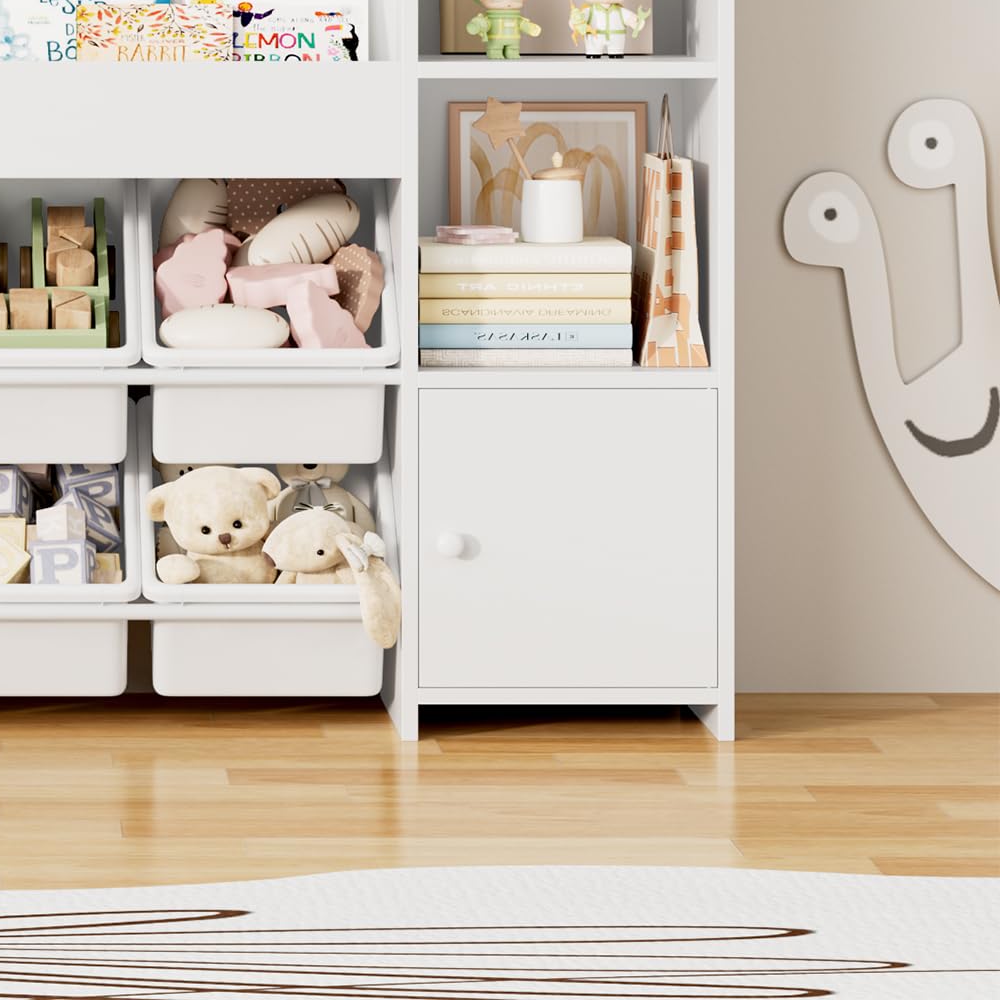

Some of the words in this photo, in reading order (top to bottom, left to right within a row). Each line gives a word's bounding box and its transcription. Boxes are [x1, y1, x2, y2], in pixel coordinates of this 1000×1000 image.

[47, 39, 77, 62] Bô
[233, 32, 315, 49] LEMON
[40, 547, 79, 584] P
